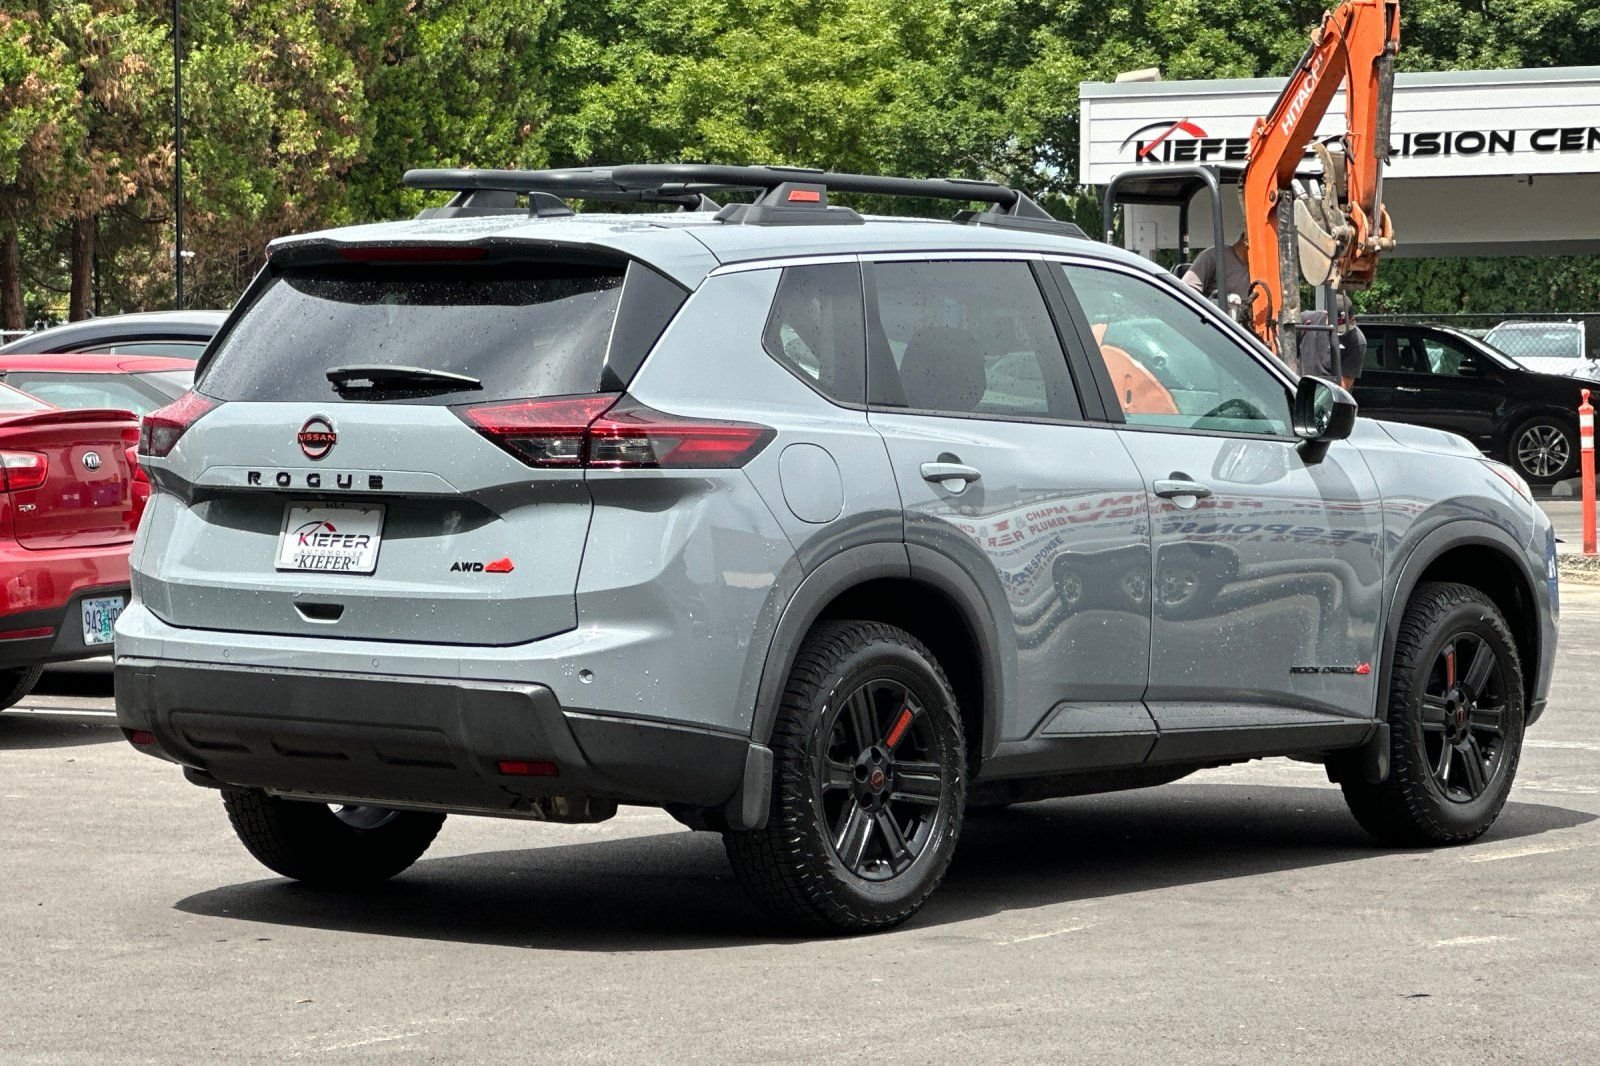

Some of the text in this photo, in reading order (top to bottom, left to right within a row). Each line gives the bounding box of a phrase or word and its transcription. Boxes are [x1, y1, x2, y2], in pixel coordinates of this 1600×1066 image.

[1136, 138, 1250, 163] KIEFE
[298, 433, 336, 442] NISSAN
[247, 471, 384, 489] ROGUE
[298, 532, 371, 549] KIEFER
[450, 562, 484, 573] AWD
